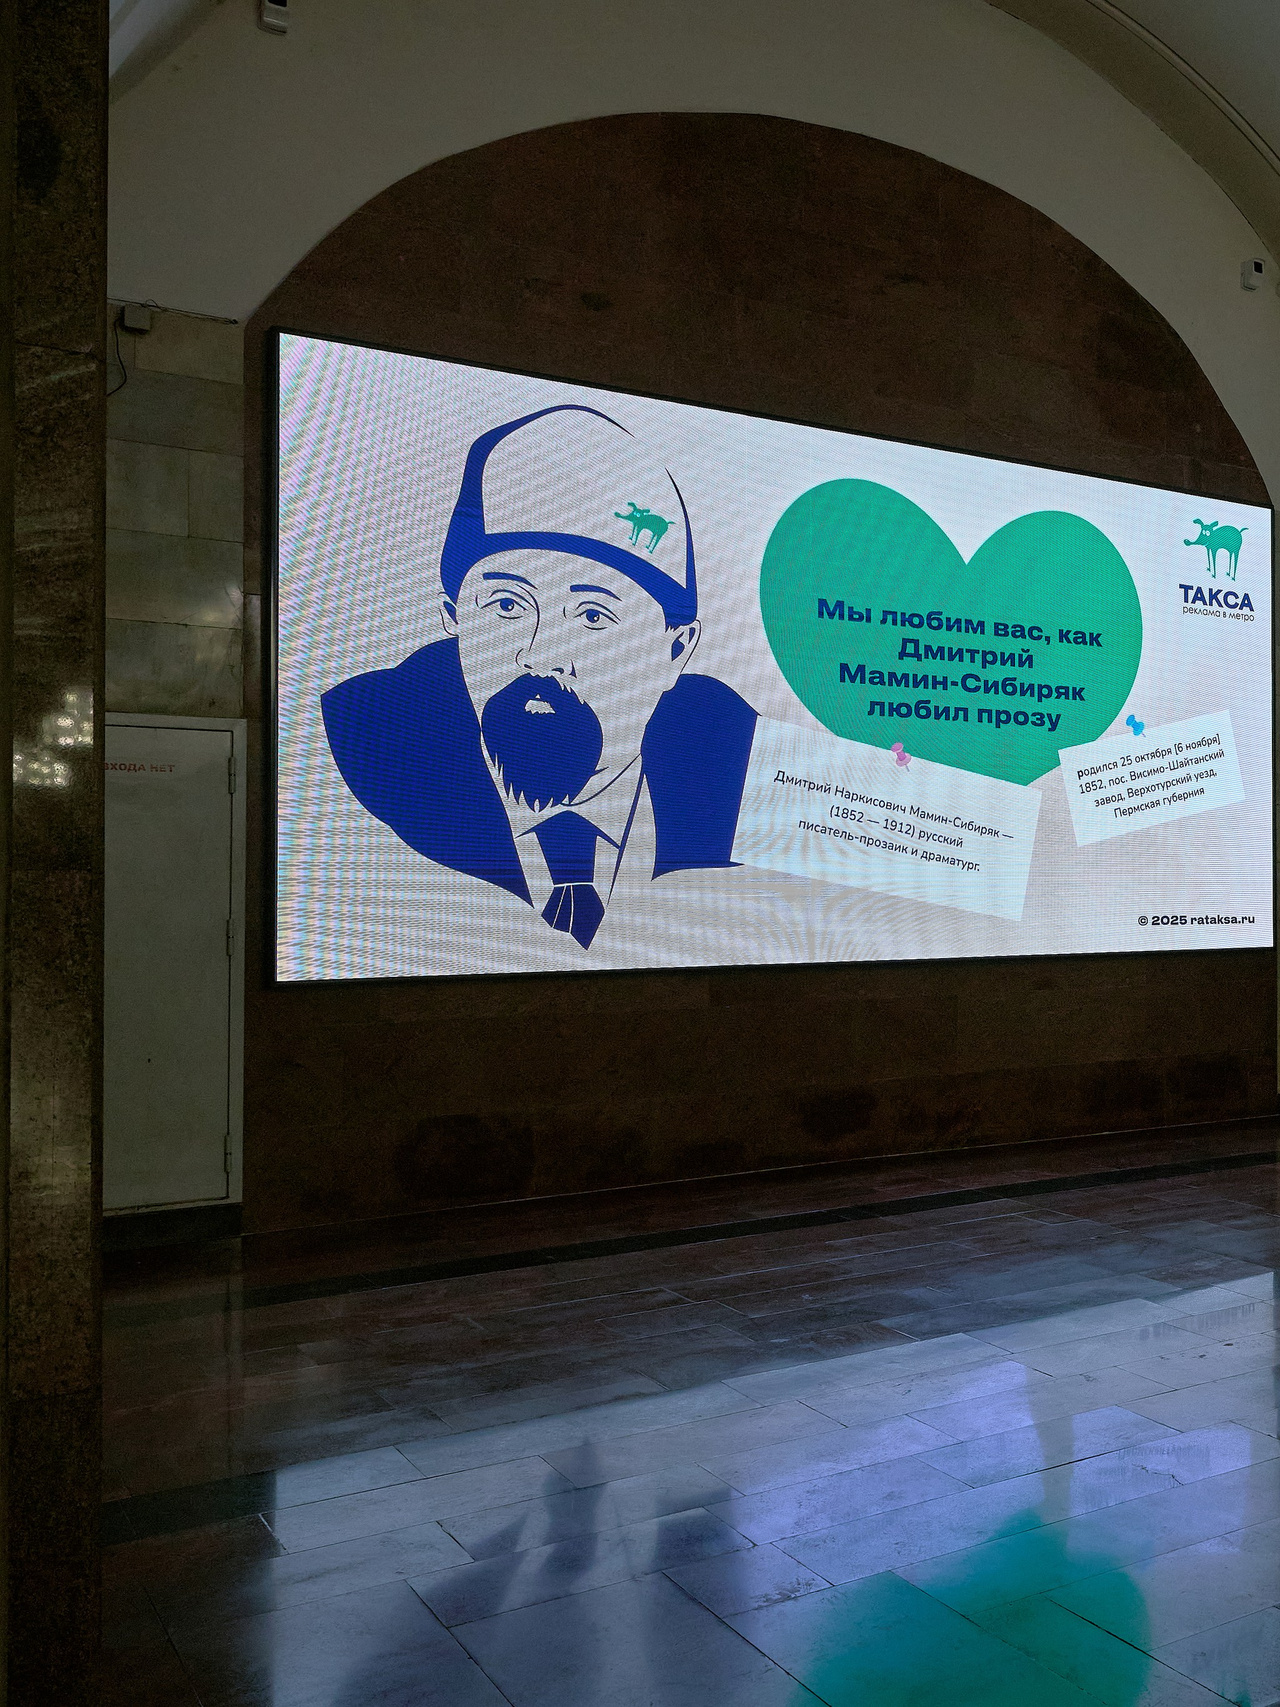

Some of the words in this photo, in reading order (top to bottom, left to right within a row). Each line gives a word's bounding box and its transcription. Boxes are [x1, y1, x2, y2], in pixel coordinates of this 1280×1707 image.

[1179, 583, 1255, 612] ТАКСА
[1182, 606, 1221, 618] реклама
[1222, 611, 1227, 619] в
[1228, 612, 1255, 623] метро
[817, 597, 872, 624] Мы
[879, 609, 986, 636] любим
[993, 621, 1051, 646] вас,
[1058, 628, 1104, 648] как
[897, 637, 1034, 670] Дмитрий
[839, 662, 1087, 703] Мамин-Сибиряк
[867, 699, 969, 723] любил
[977, 708, 1063, 732] прозу
[150, 763, 175, 773] НЕТ
[1076, 760, 1119, 781] родился
[1119, 754, 1134, 768] 25
[1134, 746, 1173, 764] октября
[1173, 742, 1184, 756] [6
[1185, 733, 1221, 751] ноября]
[1078, 778, 1108, 795] 1852,
[1108, 774, 1129, 788] пос.
[1129, 748, 1226, 781] Висимо-Шайтанский
[773, 769, 832, 795] Дмитрий
[834, 785, 907, 815] Наркисович
[909, 804, 1001, 838] Мамин-Сибиряк
[1094, 792, 1126, 808] завод,
[1126, 772, 1193, 799] Верхотурский
[1113, 797, 1162, 819] Пермская
[1162, 786, 1206, 806] губерния
[829, 804, 865, 824] (1852
[882, 818, 916, 838] 1912)
[917, 828, 964, 849] русский
[798, 819, 909, 855] писатель-прозаик
[910, 846, 918, 857] и
[920, 849, 981, 872] драматург.
[1151, 915, 1188, 926] 2025
[1190, 914, 1256, 925] rataksa.ru
